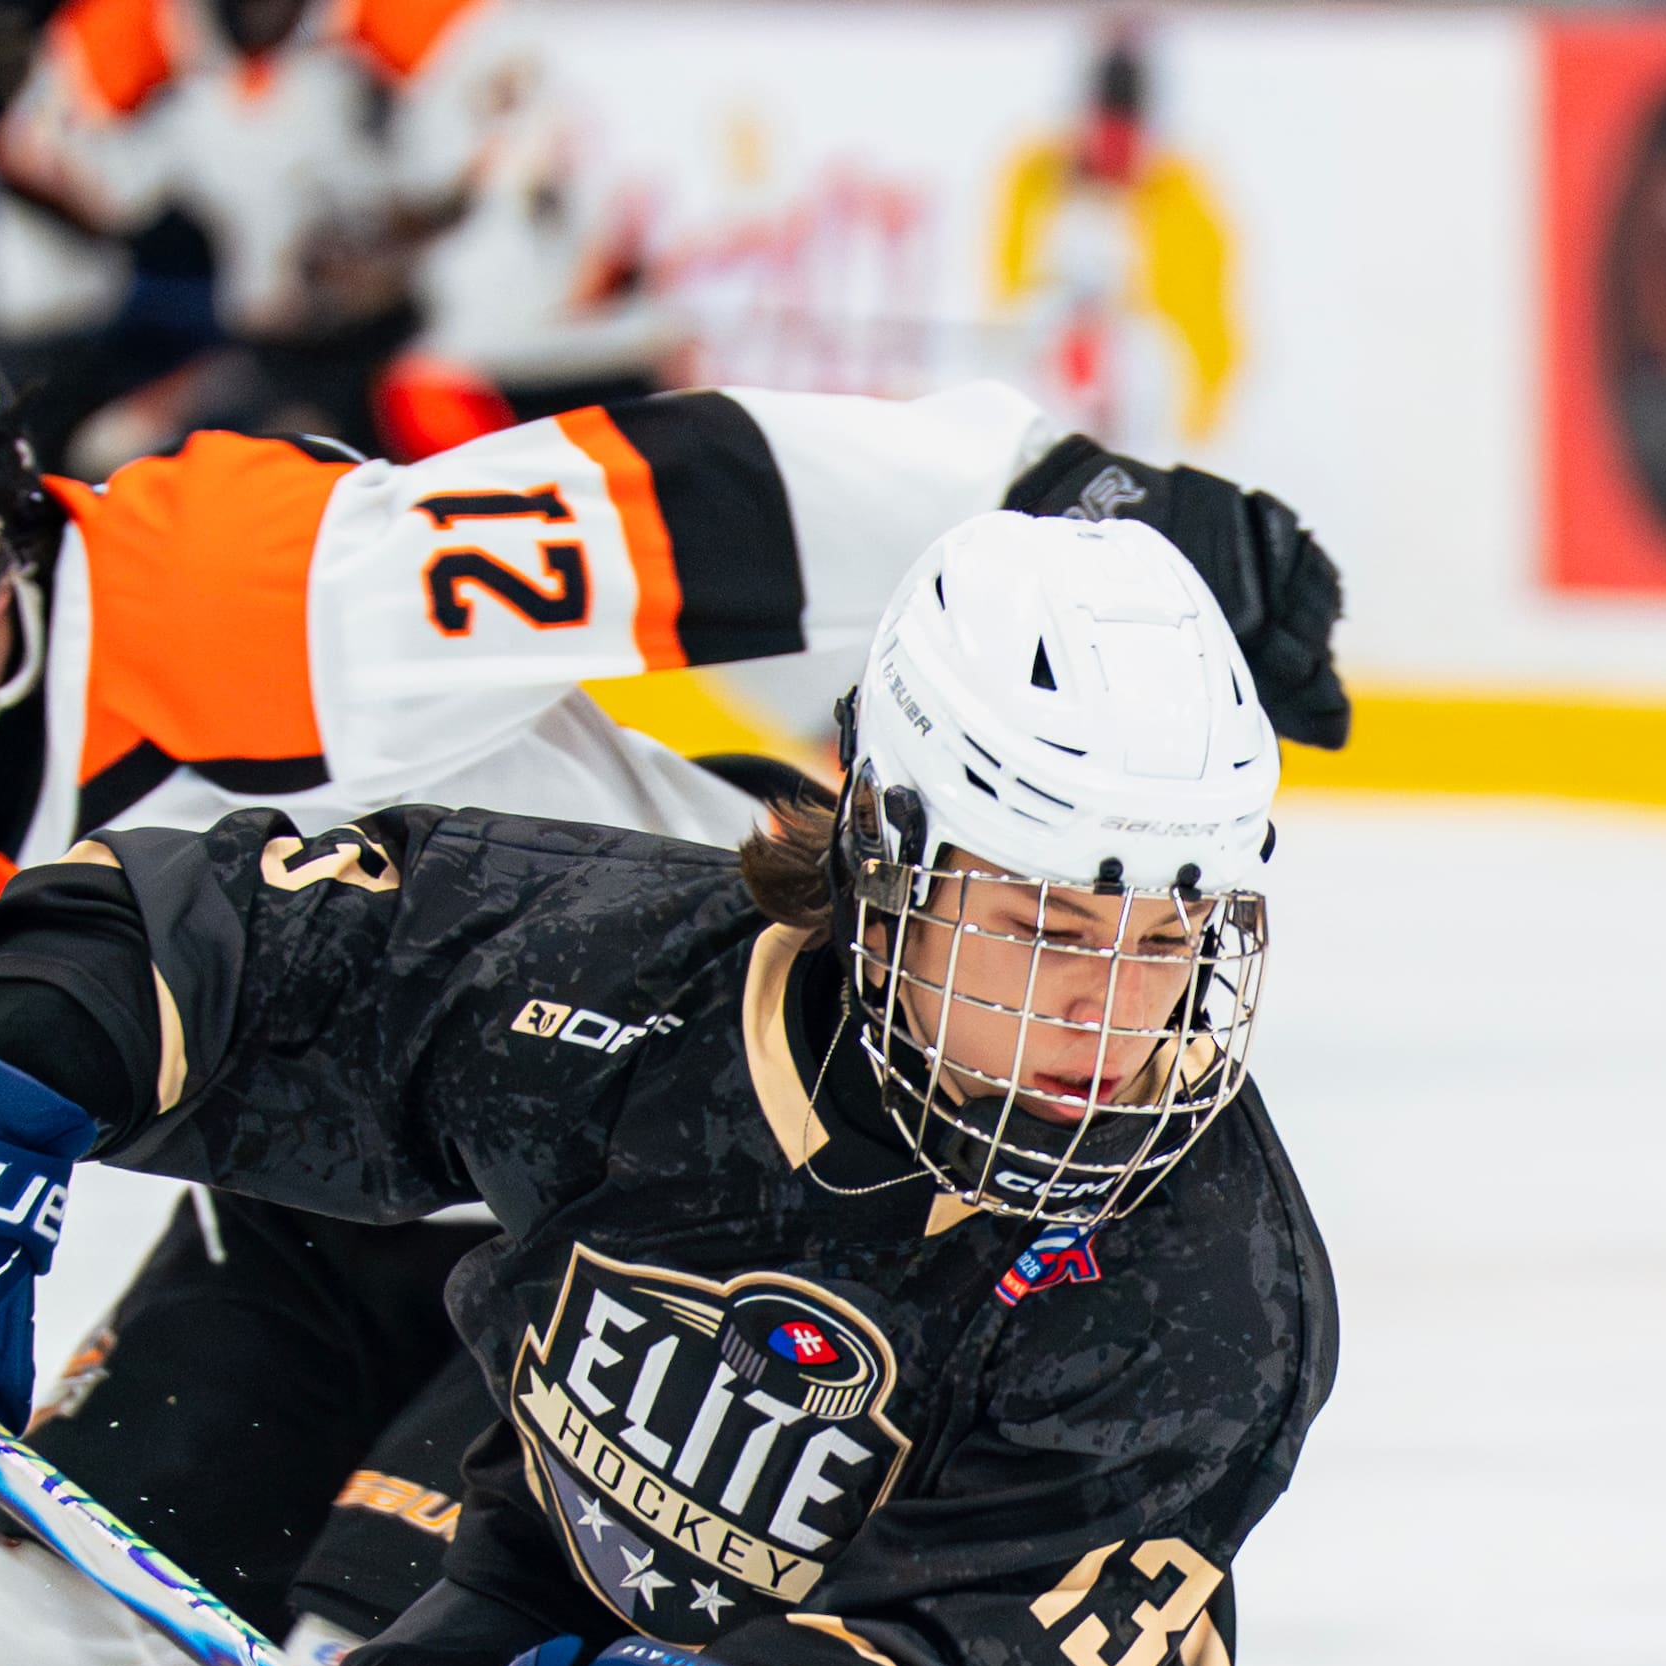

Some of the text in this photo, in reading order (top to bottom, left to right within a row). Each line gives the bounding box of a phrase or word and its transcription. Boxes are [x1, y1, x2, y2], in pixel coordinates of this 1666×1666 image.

[413, 483, 591, 637] 21
[994, 1170, 1116, 1198] CCM
[558, 1405, 801, 1589] HOCKEY
[566, 1288, 874, 1552] ELITE
